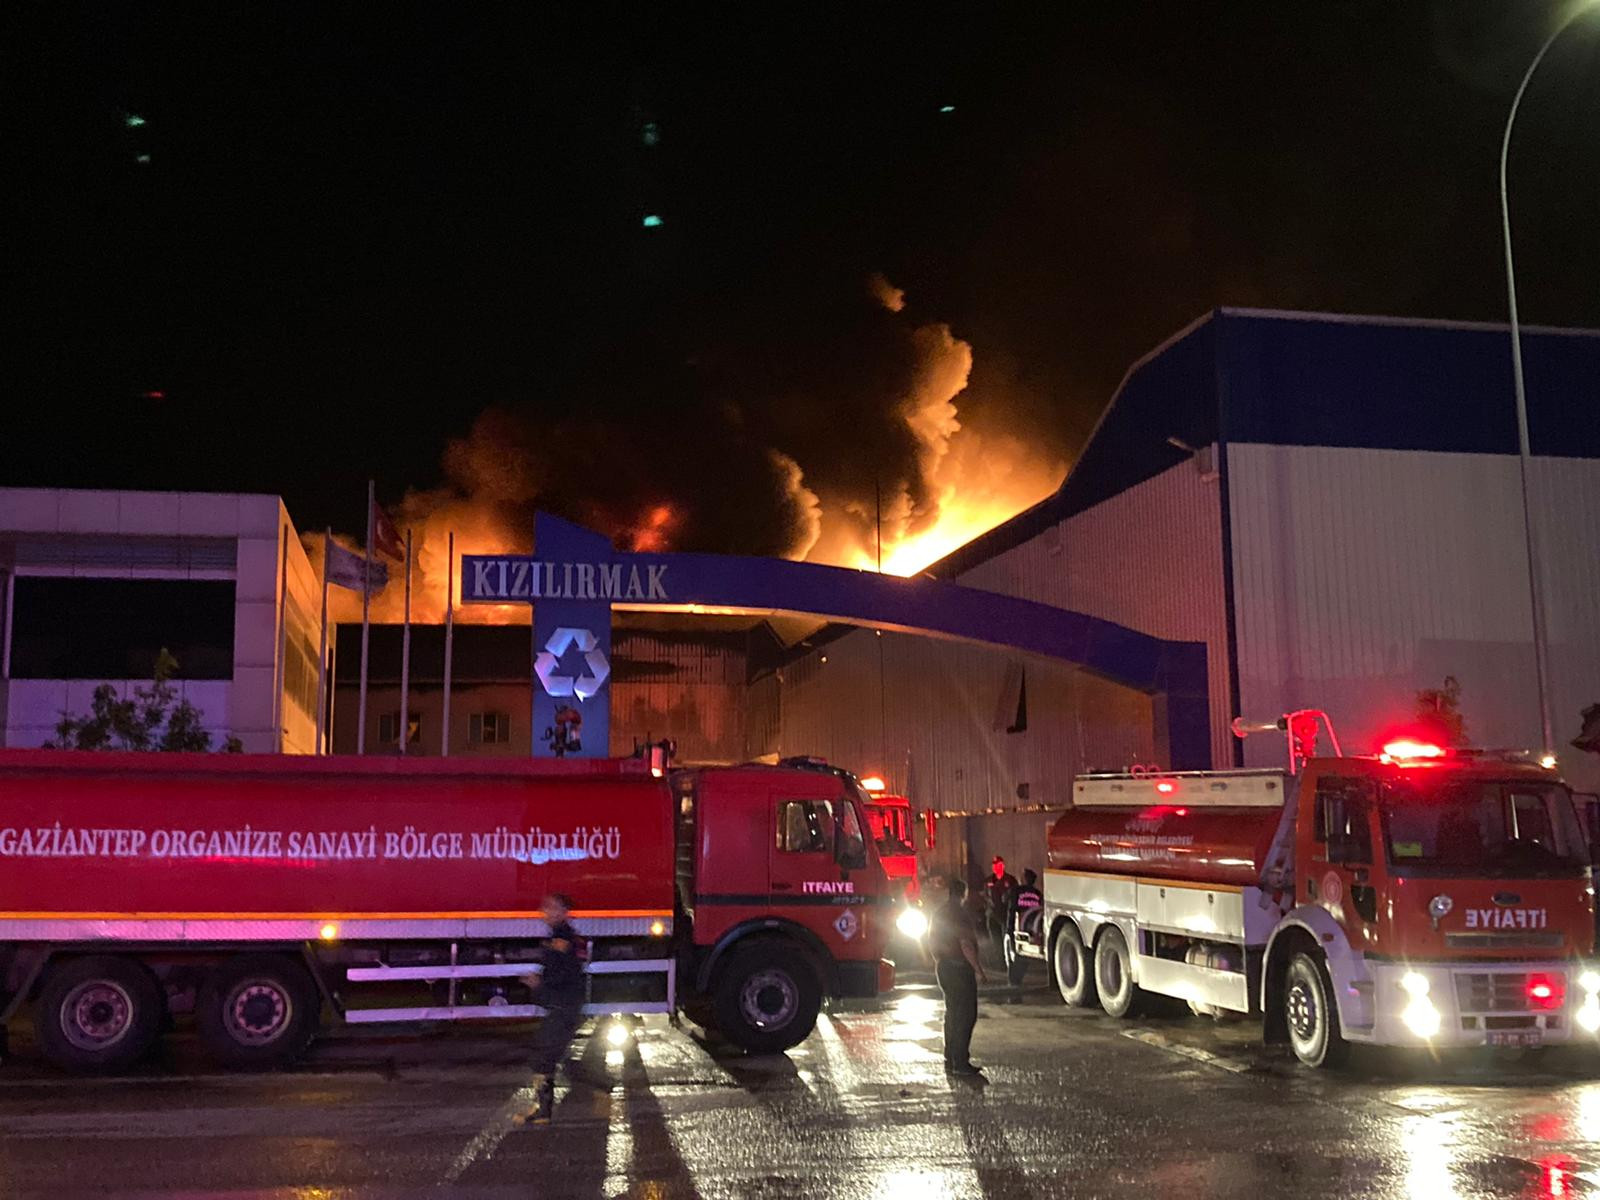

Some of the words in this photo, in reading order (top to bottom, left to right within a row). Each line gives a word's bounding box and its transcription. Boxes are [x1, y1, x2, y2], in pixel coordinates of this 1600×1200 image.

[472, 560, 669, 600] KIZILIRMAK
[0, 820, 147, 856] GAZİANTEP
[151, 824, 282, 857] ORGANİZE
[287, 825, 376, 859] SANAYİ
[384, 825, 463, 860] BÖLGE
[470, 826, 621, 860] MÜDÜRLÜĞÜ
